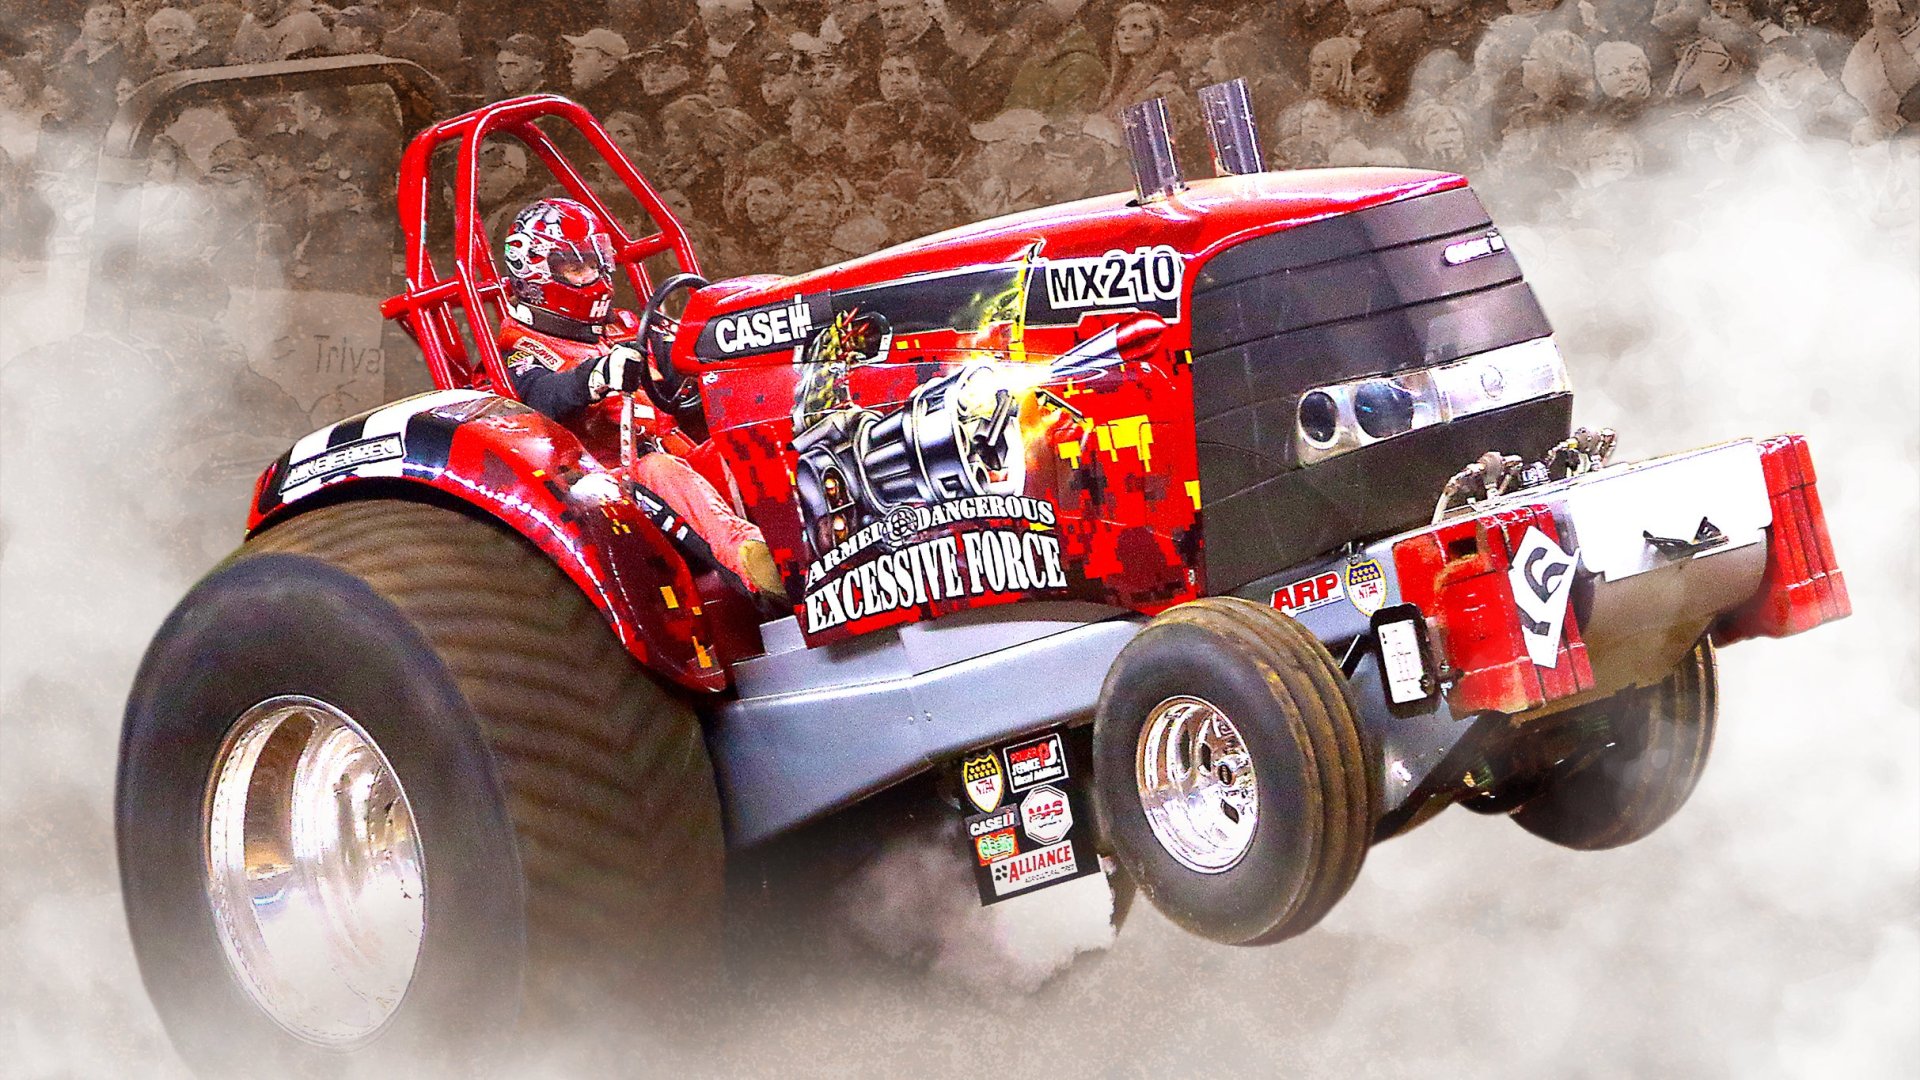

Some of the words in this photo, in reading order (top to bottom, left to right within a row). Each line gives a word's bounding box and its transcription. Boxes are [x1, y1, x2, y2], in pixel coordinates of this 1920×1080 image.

[1050, 250, 1175, 303] MX210
[918, 497, 1056, 531] DANGEROUS
[805, 543, 964, 633] EXCESSIVE
[962, 530, 1068, 594] FORCE
[1273, 573, 1338, 612] ARP
[1009, 845, 1072, 883] ALLIANCE
